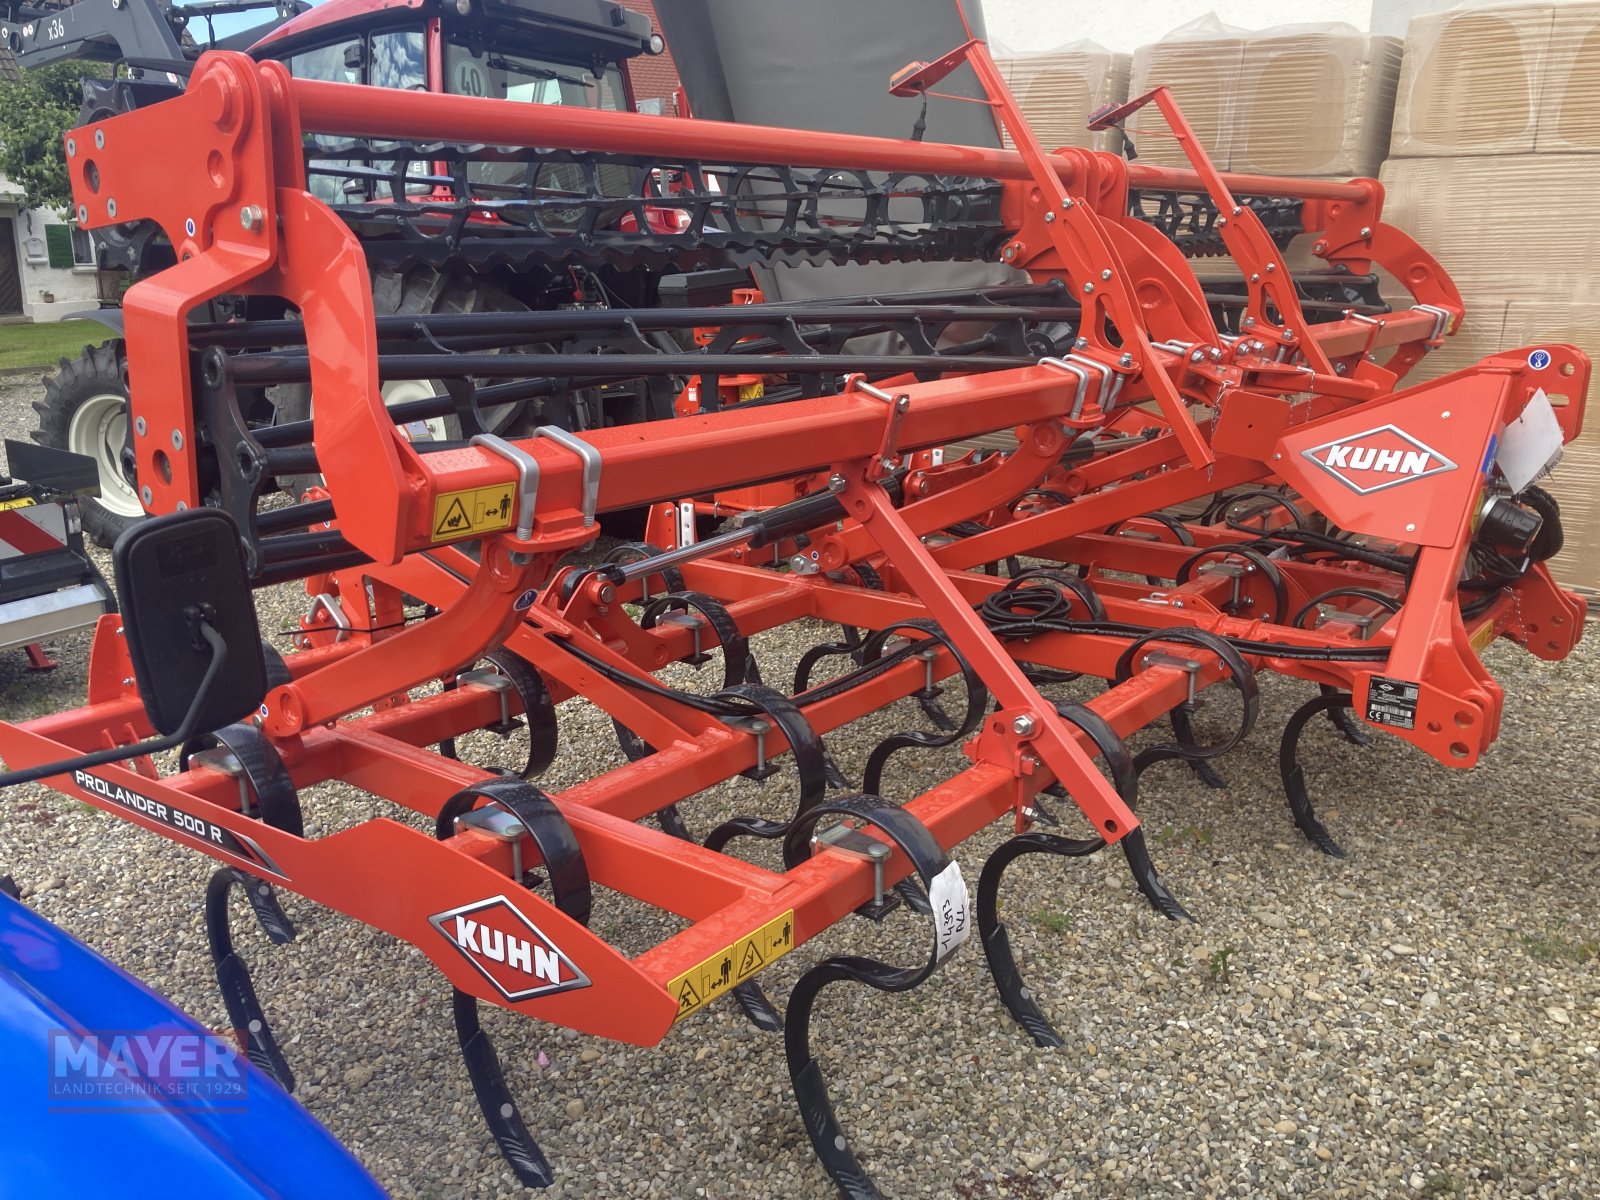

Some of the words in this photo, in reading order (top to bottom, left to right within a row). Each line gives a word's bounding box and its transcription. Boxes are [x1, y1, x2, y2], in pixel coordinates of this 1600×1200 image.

[48, 17, 65, 40] x36
[461, 66, 482, 97] 40
[1325, 445, 1431, 475] KUHN
[75, 770, 169, 821] PROLANDER
[173, 810, 206, 836] 500
[210, 824, 223, 844] R
[941, 899, 955, 950] 14393
[455, 915, 560, 986] KUHN
